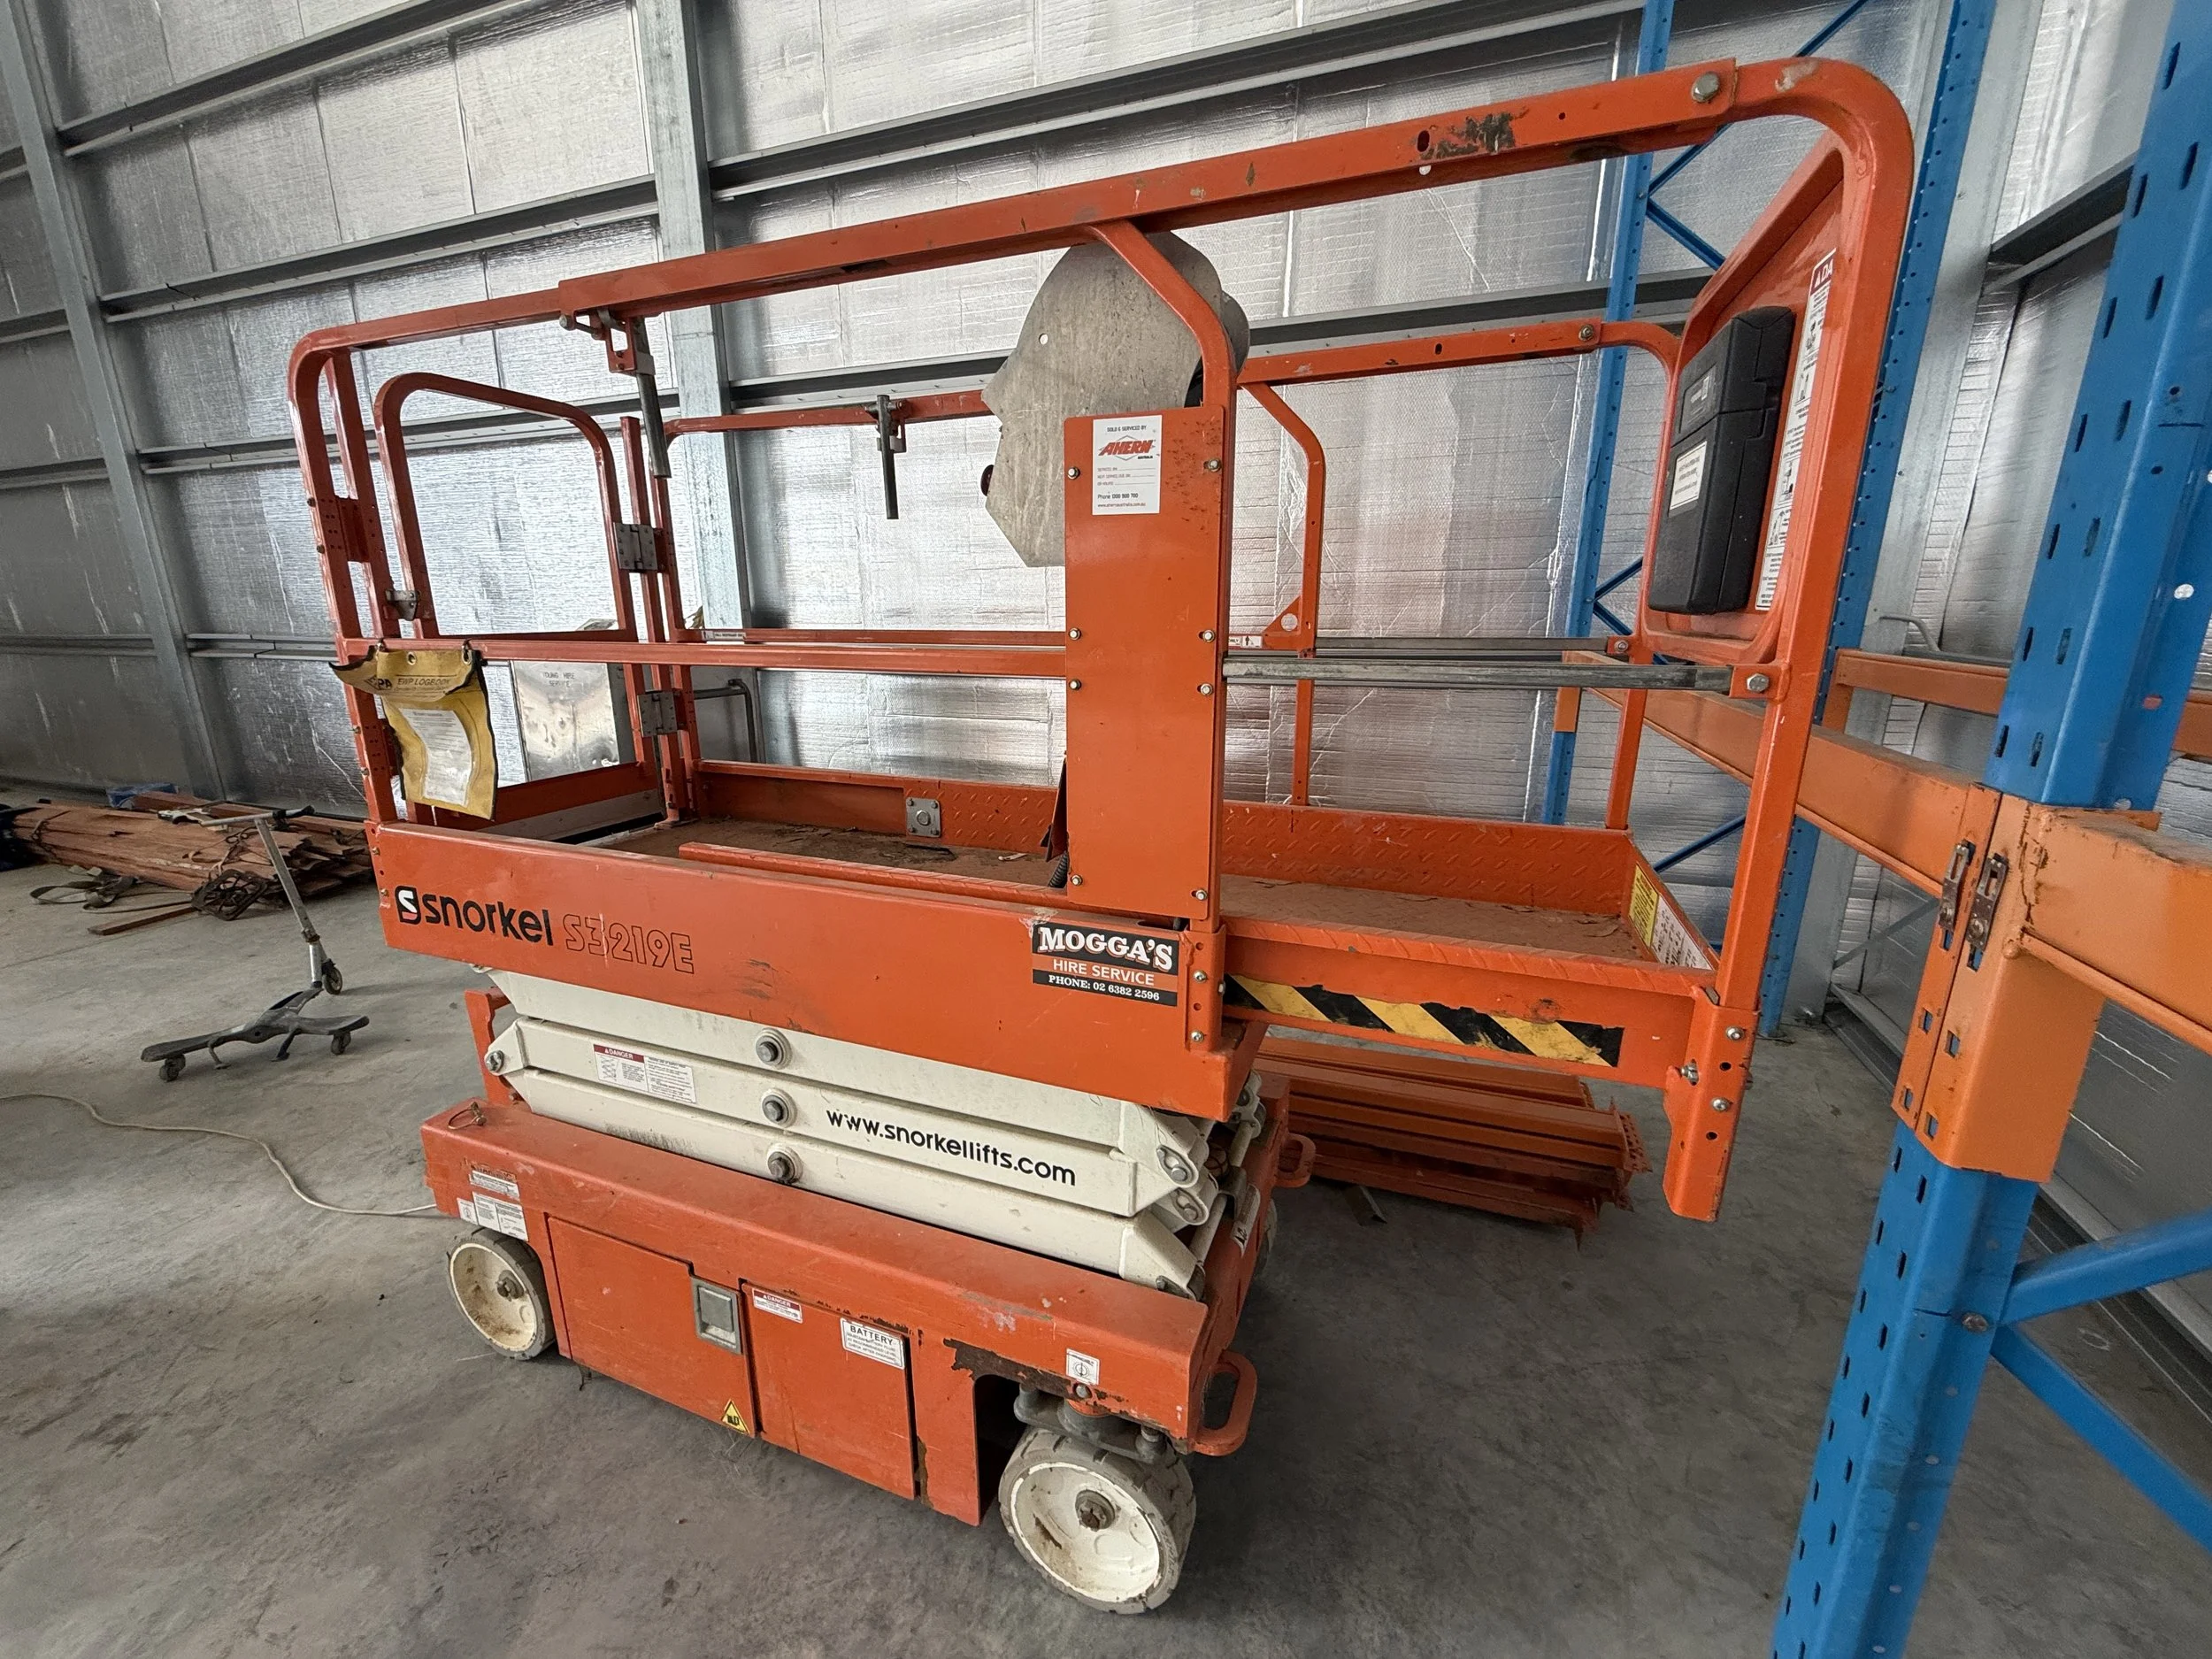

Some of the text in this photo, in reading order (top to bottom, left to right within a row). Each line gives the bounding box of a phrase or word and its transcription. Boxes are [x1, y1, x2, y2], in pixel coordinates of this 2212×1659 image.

[1098, 440, 1154, 456] AHERN
[422, 893, 554, 946] snorkel
[563, 913, 695, 974] S3219E
[1038, 926, 1173, 972] MOGGA'S
[1053, 958, 1155, 986] HIRE SERVICE
[1048, 974, 1160, 1001] PHONE: 02 6382 2596
[609, 1048, 634, 1060] DANGER
[826, 1110, 1076, 1186] www.snorkellifts.com
[767, 1295, 791, 1307] DANGER
[850, 1325, 893, 1345] BATTERY
